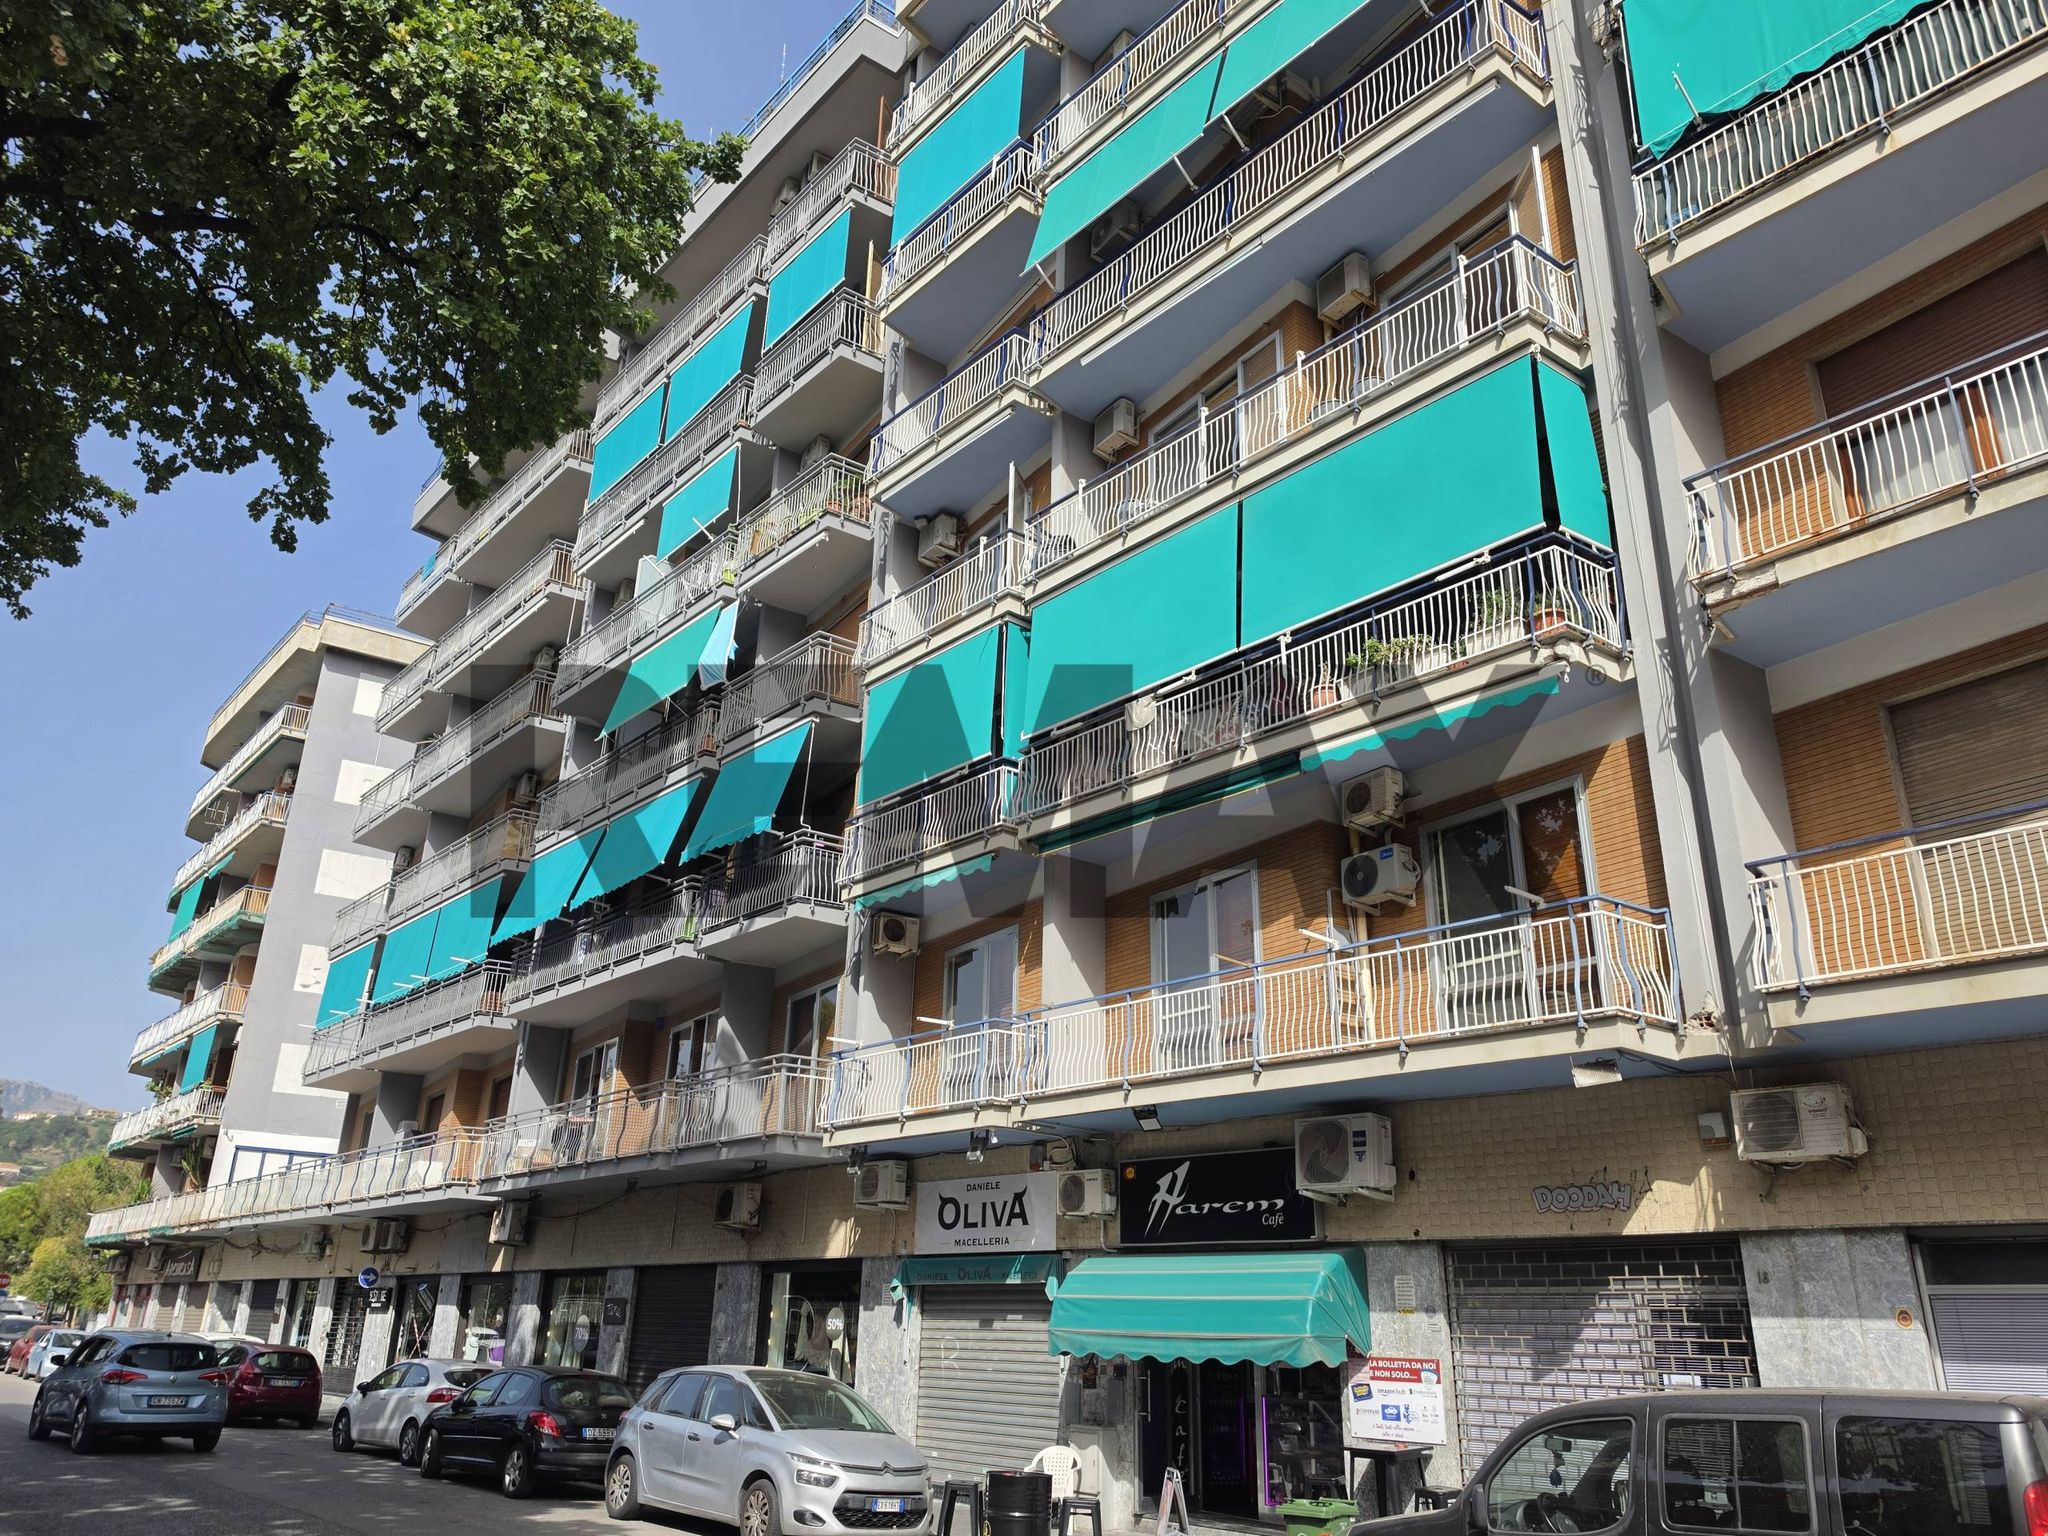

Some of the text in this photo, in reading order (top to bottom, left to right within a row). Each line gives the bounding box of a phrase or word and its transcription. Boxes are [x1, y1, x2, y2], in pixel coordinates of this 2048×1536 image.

[966, 1181, 1001, 1192] DANIELE
[1144, 1160, 1284, 1237] Harem
[1533, 1182, 1633, 1214] DOODAH
[938, 1185, 1030, 1230] OLIVA
[954, 1237, 1010, 1247] MACELLERIA
[917, 1272, 948, 1281] DANIELE
[958, 1266, 992, 1280] OLIVA
[827, 1318, 844, 1330] 50%
[1370, 1360, 1378, 1368] LA
[1378, 1360, 1411, 1369] BOLLETTA
[1375, 1370, 1390, 1378] NON
